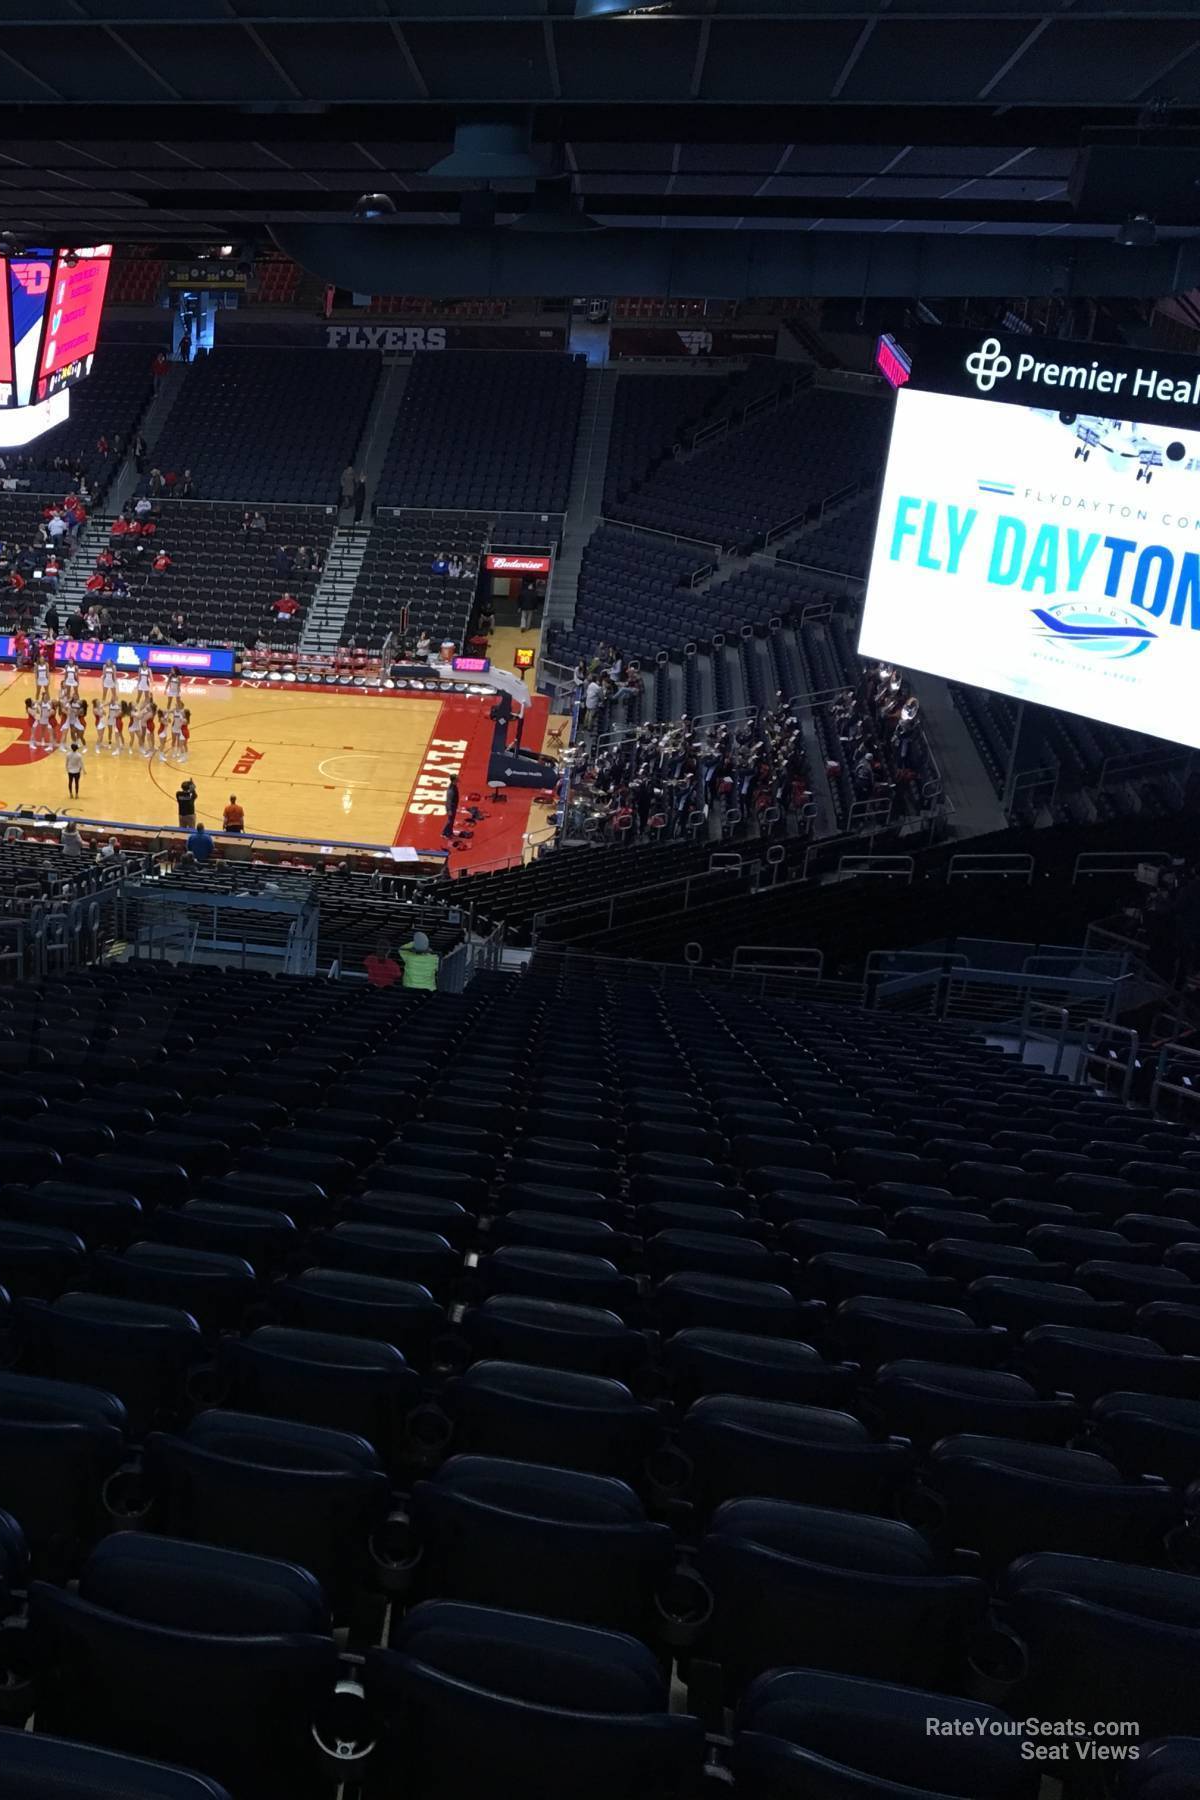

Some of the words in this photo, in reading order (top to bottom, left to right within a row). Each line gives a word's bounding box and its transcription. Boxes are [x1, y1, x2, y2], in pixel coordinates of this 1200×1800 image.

[326, 326, 447, 350] FLYERS
[1016, 353, 1128, 394] Premier
[1024, 487, 1148, 520] FLYDAYTON
[889, 495, 977, 574] FLY
[493, 558, 544, 569] Budweiser
[408, 738, 468, 817] FLYERS
